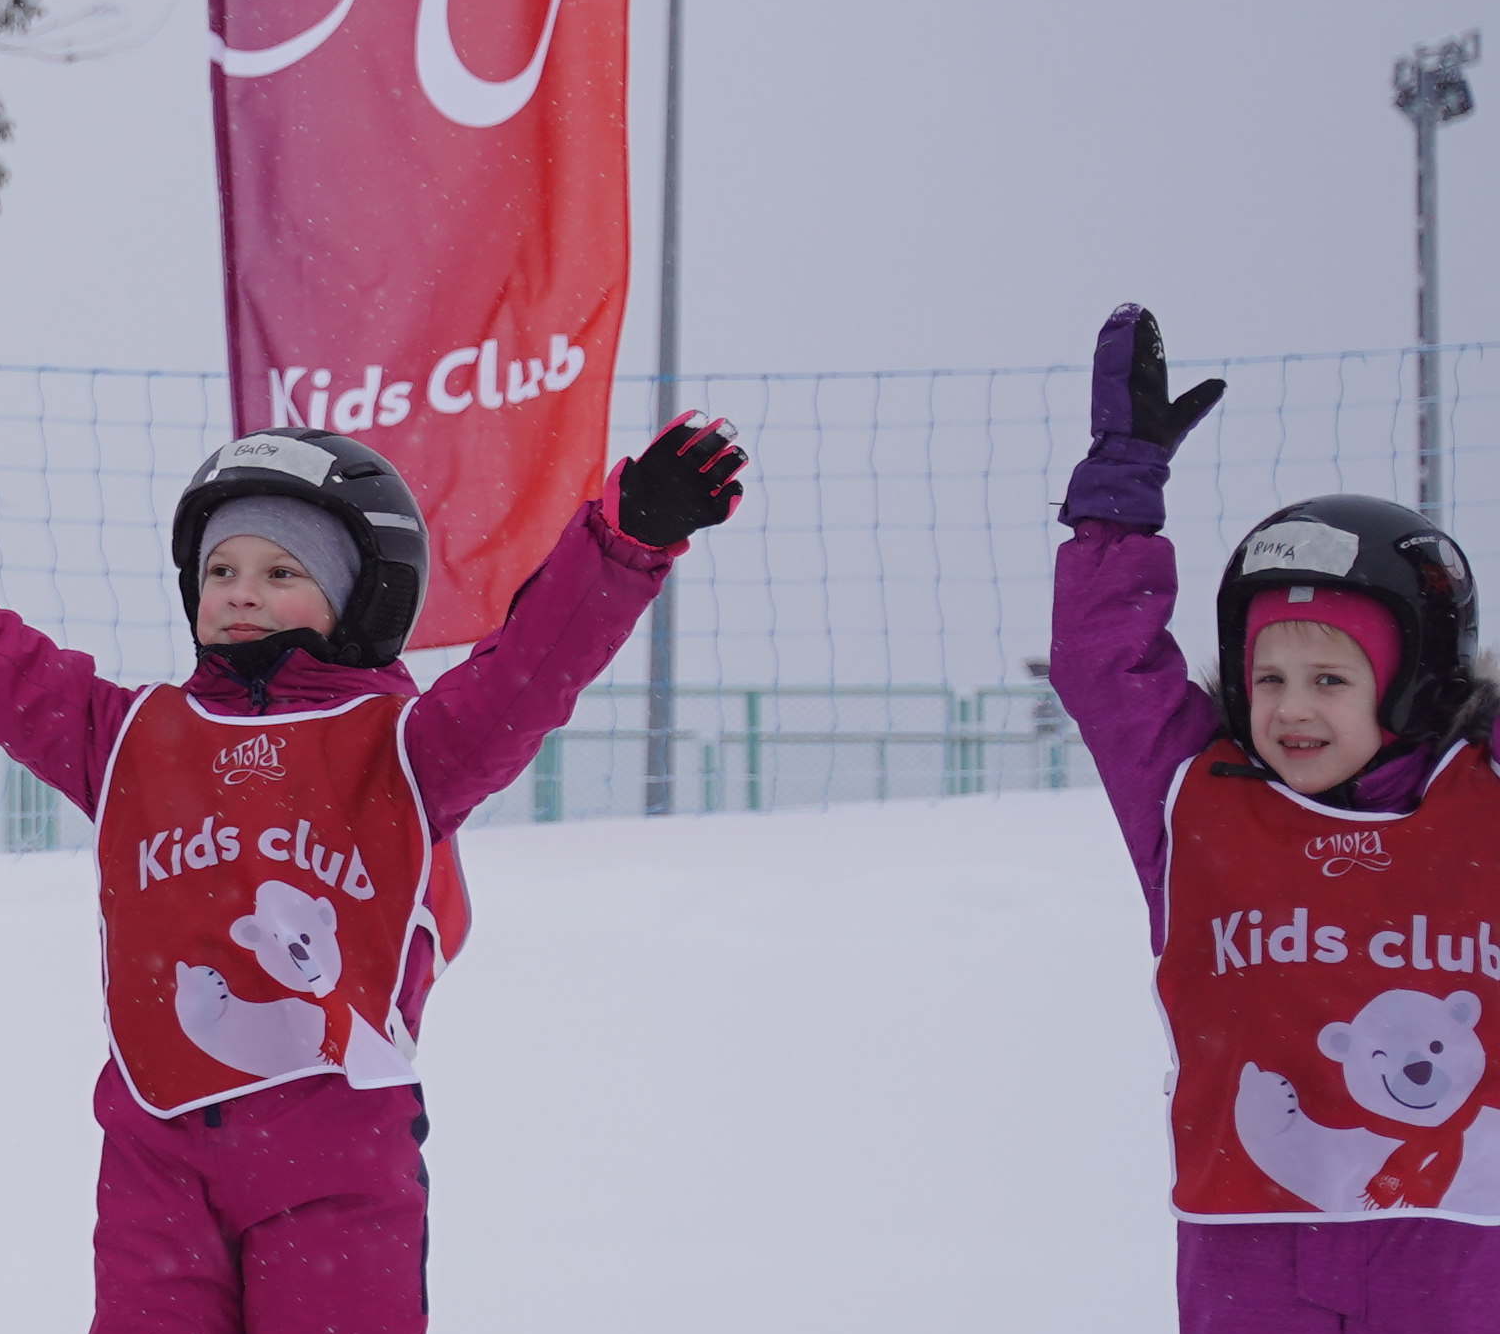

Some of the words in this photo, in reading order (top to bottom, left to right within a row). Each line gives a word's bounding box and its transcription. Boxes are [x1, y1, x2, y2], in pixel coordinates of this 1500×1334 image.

[268, 365, 414, 435] Kids
[427, 333, 586, 414] Club
[139, 815, 241, 892] Kids
[257, 818, 376, 901] club
[1211, 907, 1349, 976] Kids
[1368, 914, 1500, 981] club
